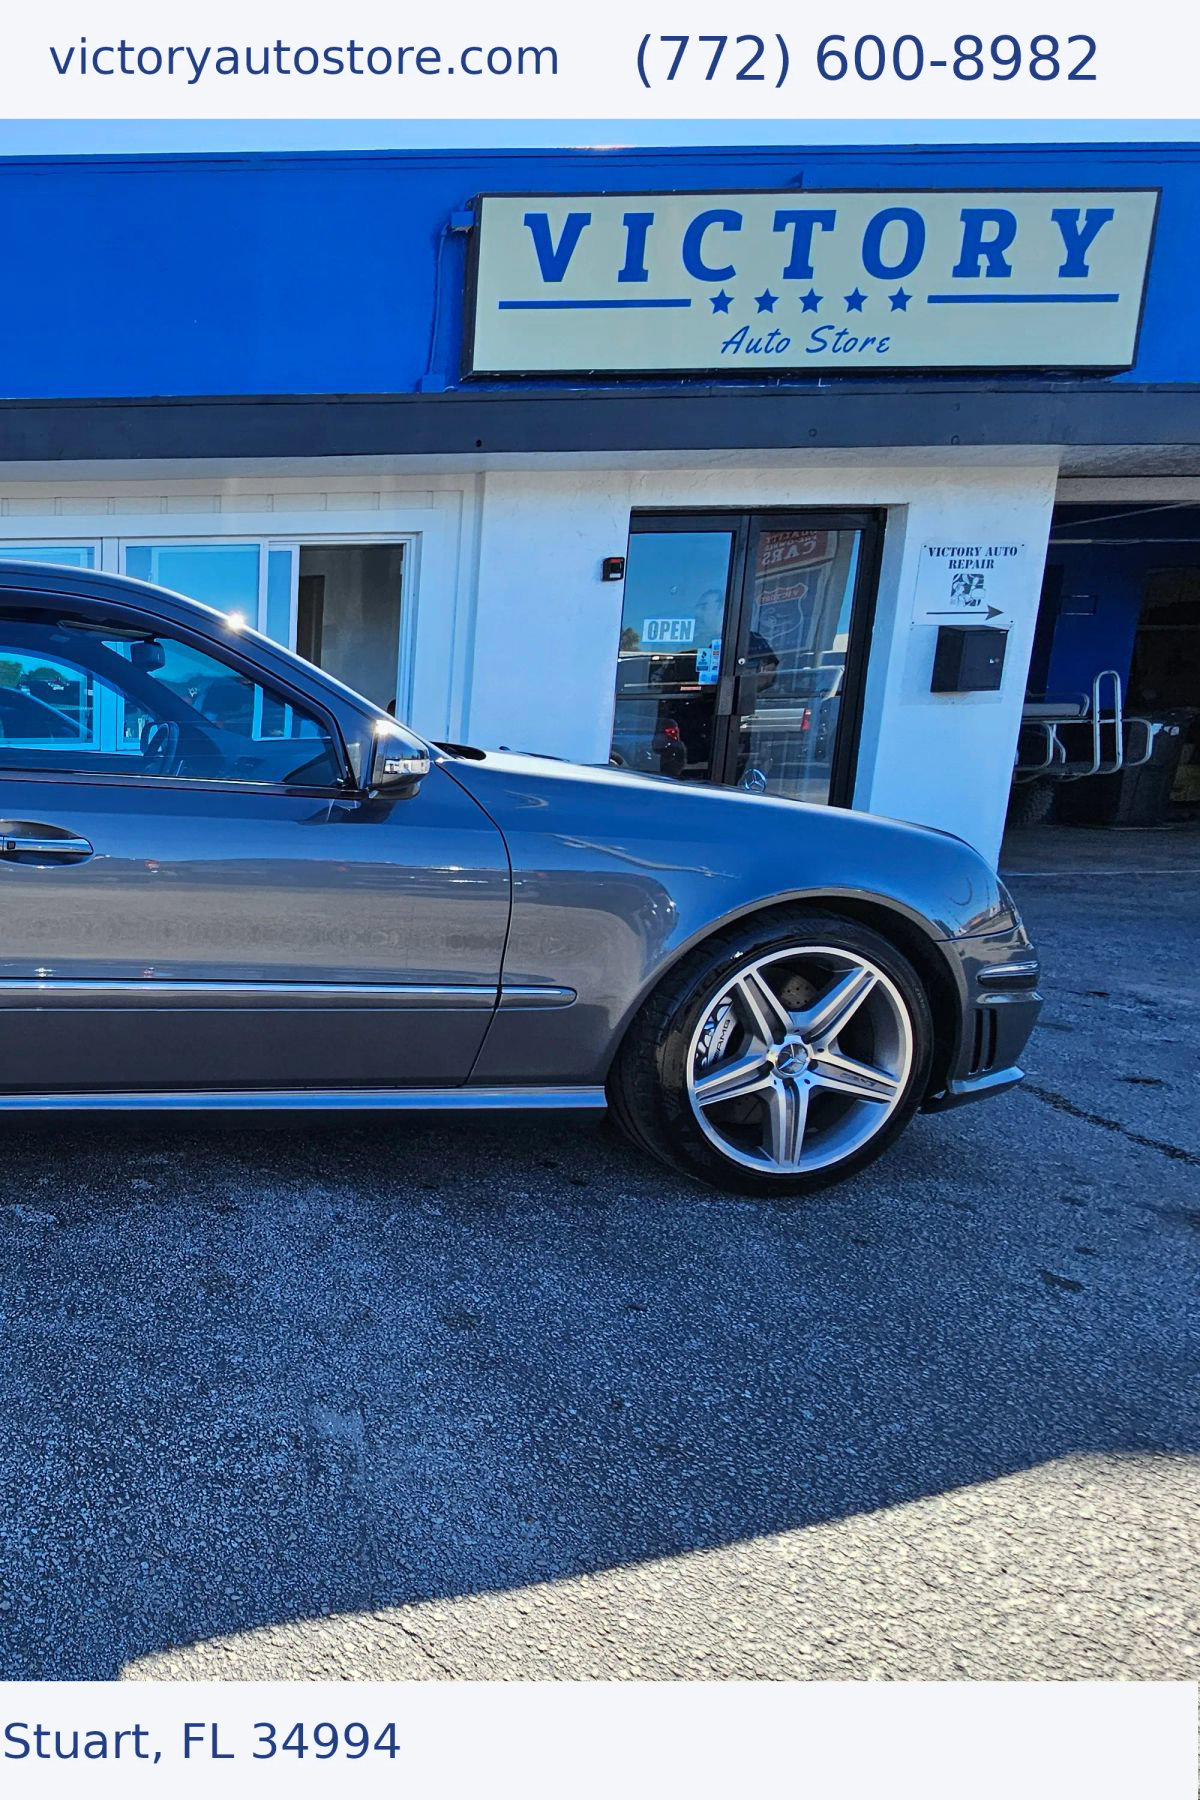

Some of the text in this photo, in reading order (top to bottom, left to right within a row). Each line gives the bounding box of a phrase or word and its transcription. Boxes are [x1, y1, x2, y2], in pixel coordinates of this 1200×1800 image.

[522, 206, 1116, 283] VICTORY
[720, 324, 891, 355] Auto Store
[928, 546, 1018, 557] VICTORY AUTO
[948, 559, 994, 569] REPAIR
[647, 620, 692, 640] OPEN
